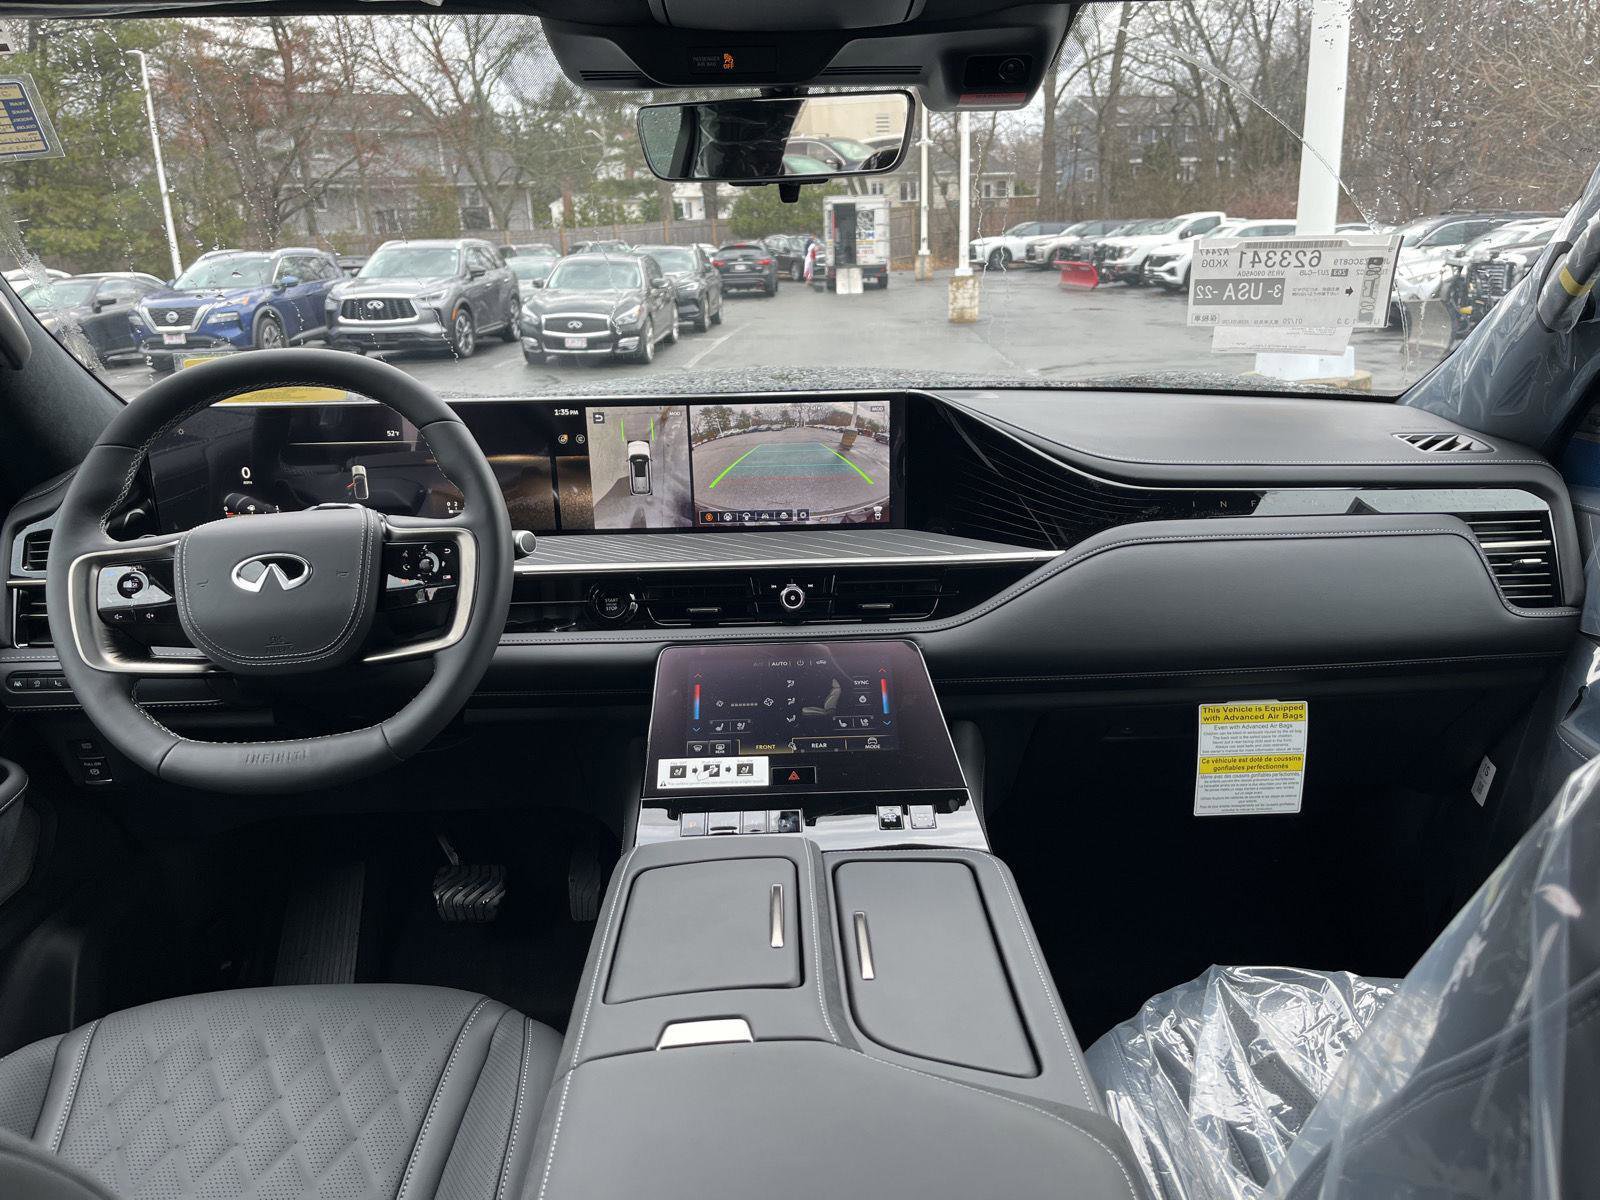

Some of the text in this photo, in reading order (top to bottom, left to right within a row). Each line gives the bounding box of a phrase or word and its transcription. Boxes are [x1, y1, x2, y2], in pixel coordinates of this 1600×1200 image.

[241, 466, 251, 478] 0
[1265, 704, 1304, 713] Equipped
[1283, 712, 1303, 720] Bags
